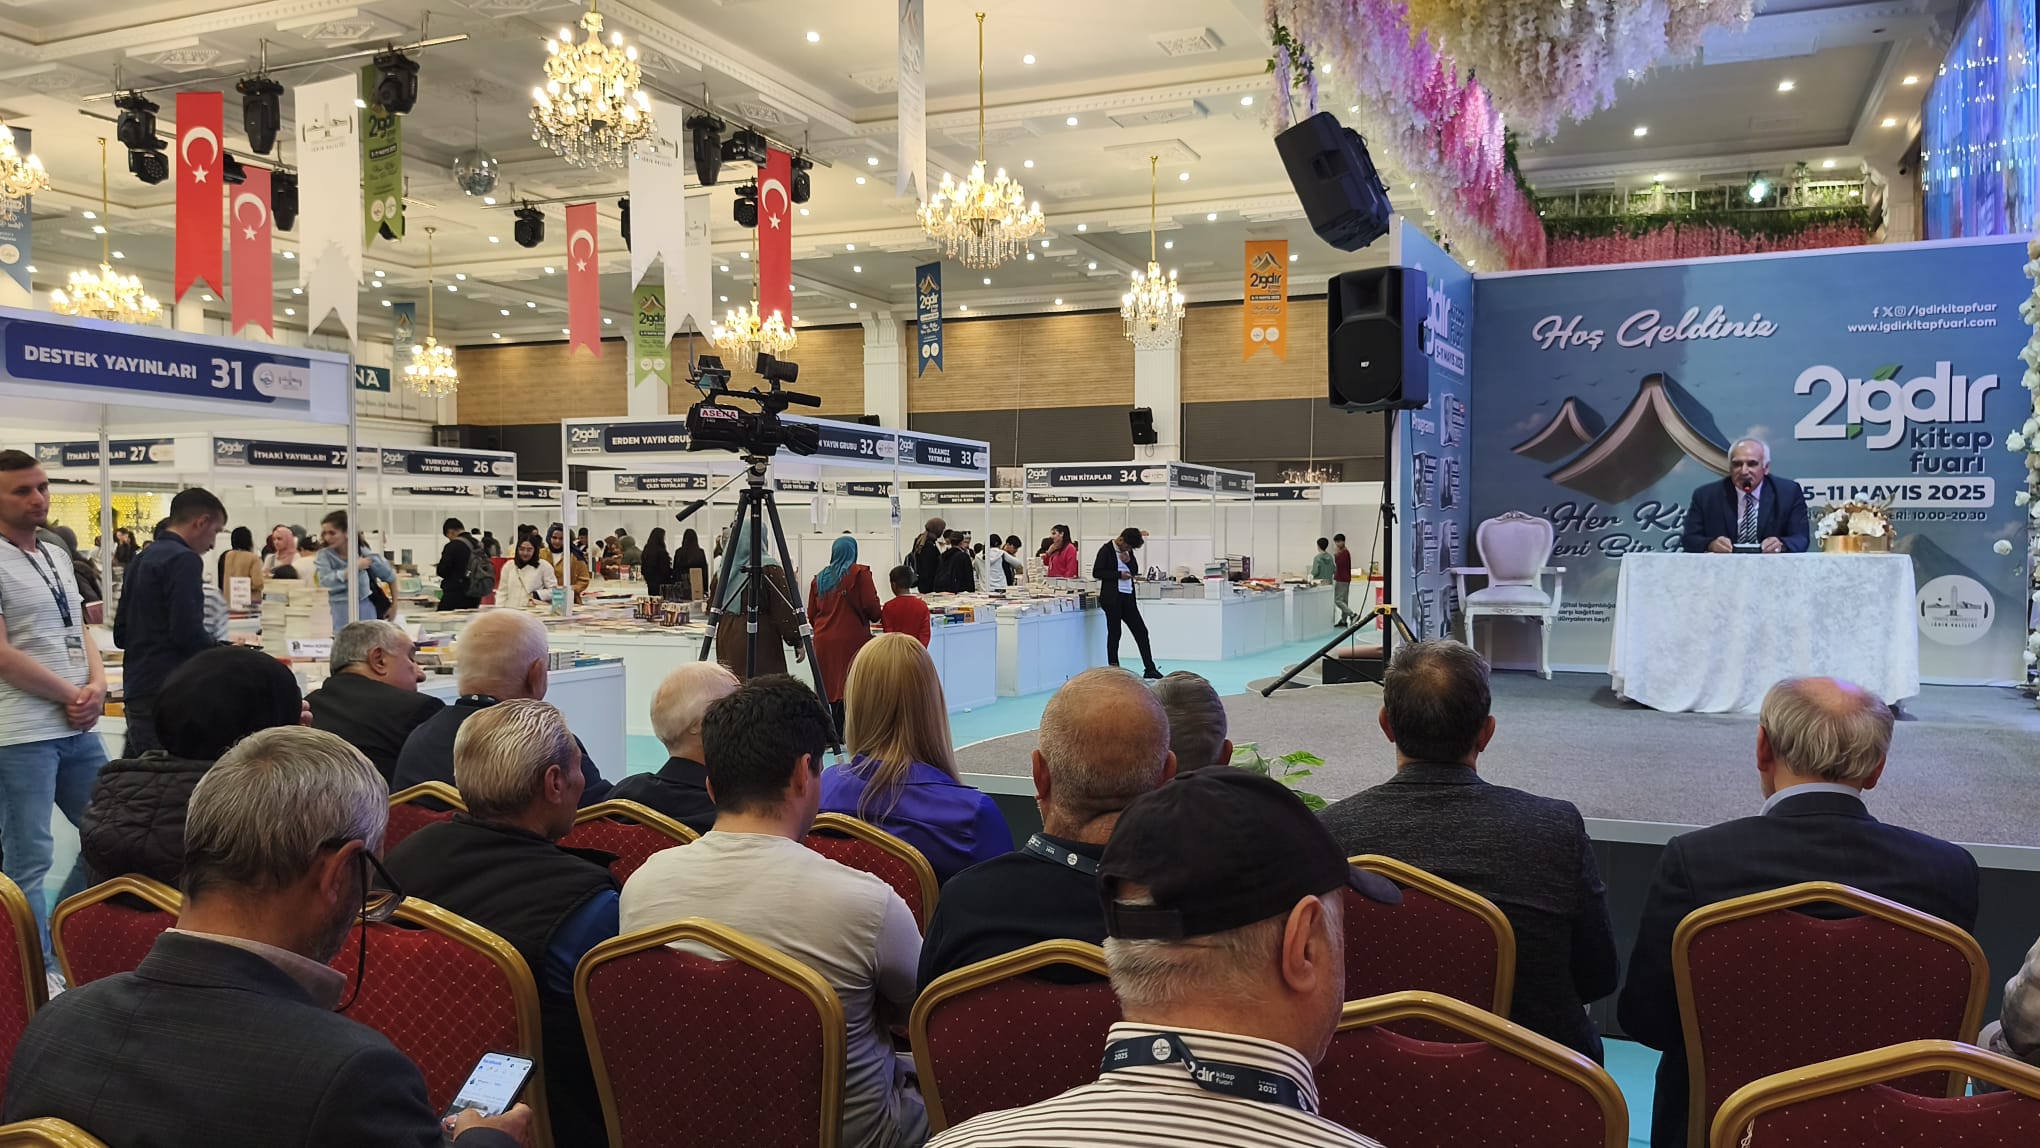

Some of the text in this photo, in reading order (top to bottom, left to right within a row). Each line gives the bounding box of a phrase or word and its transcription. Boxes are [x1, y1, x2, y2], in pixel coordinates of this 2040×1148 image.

[1532, 305, 1778, 351] Hoş Geldiniz
[24, 345, 243, 390] DESTEK YAYINLARI 31
[355, 368, 380, 388] NA
[702, 409, 737, 418] ASENA
[612, 436, 640, 446] ERDEM
[642, 435, 667, 445] YAYIN
[859, 439, 874, 455] 32
[1910, 427, 1994, 455] kitap
[130, 446, 146, 461] 27
[331, 451, 347, 465] 27
[961, 451, 972, 465] 33
[473, 460, 489, 474] 26
[693, 477, 706, 488] 25
[1119, 470, 1138, 483] 34
[538, 488, 548, 498] 23
[878, 484, 886, 495] 24
[1292, 490, 1299, 499] 7
[1928, 485, 1986, 501] 2025
[1114, 1052, 1128, 1061] 2025
[1216, 1072, 1235, 1081] kitap
[1258, 1084, 1278, 1094] 2025
